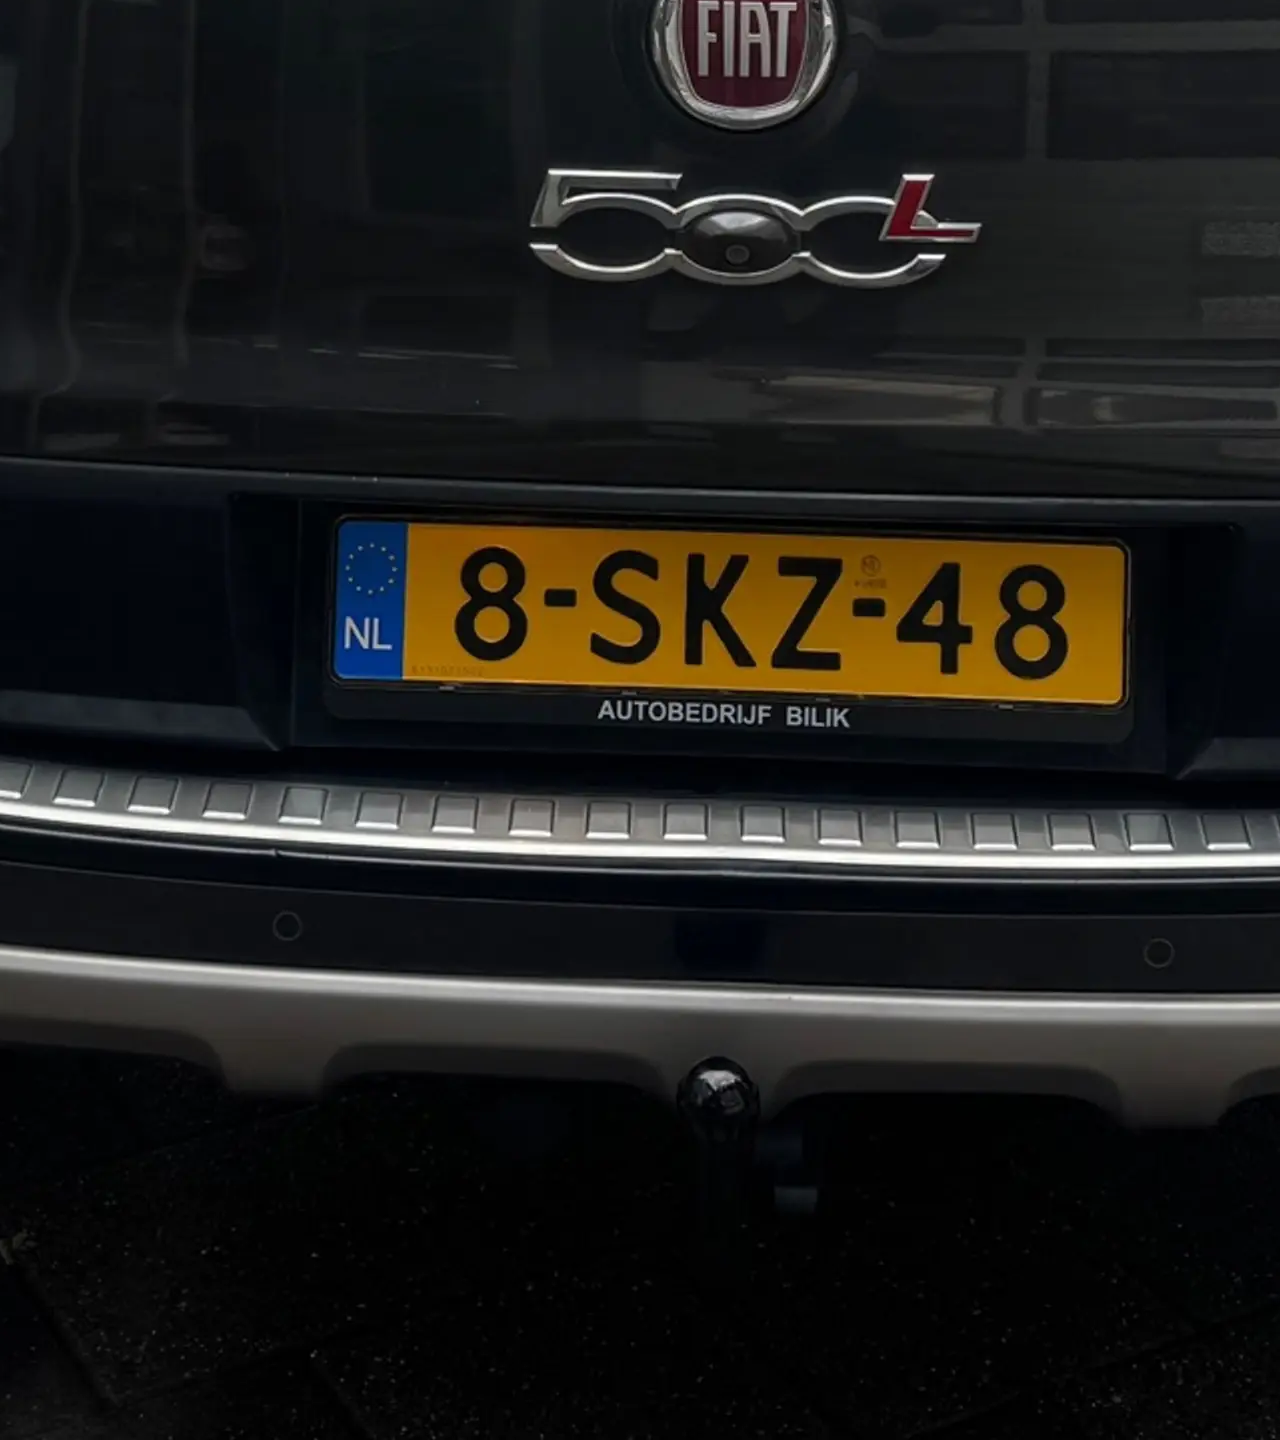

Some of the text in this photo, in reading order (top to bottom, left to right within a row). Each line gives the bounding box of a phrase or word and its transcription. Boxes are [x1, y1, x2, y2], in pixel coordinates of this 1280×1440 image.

[697, 0, 797, 78] FIAT
[528, 168, 983, 289] 500L
[343, 615, 393, 652] NL
[453, 545, 1070, 681] 8-SKZ-48
[597, 700, 851, 729] AUTOBEDRIJF BILIK
